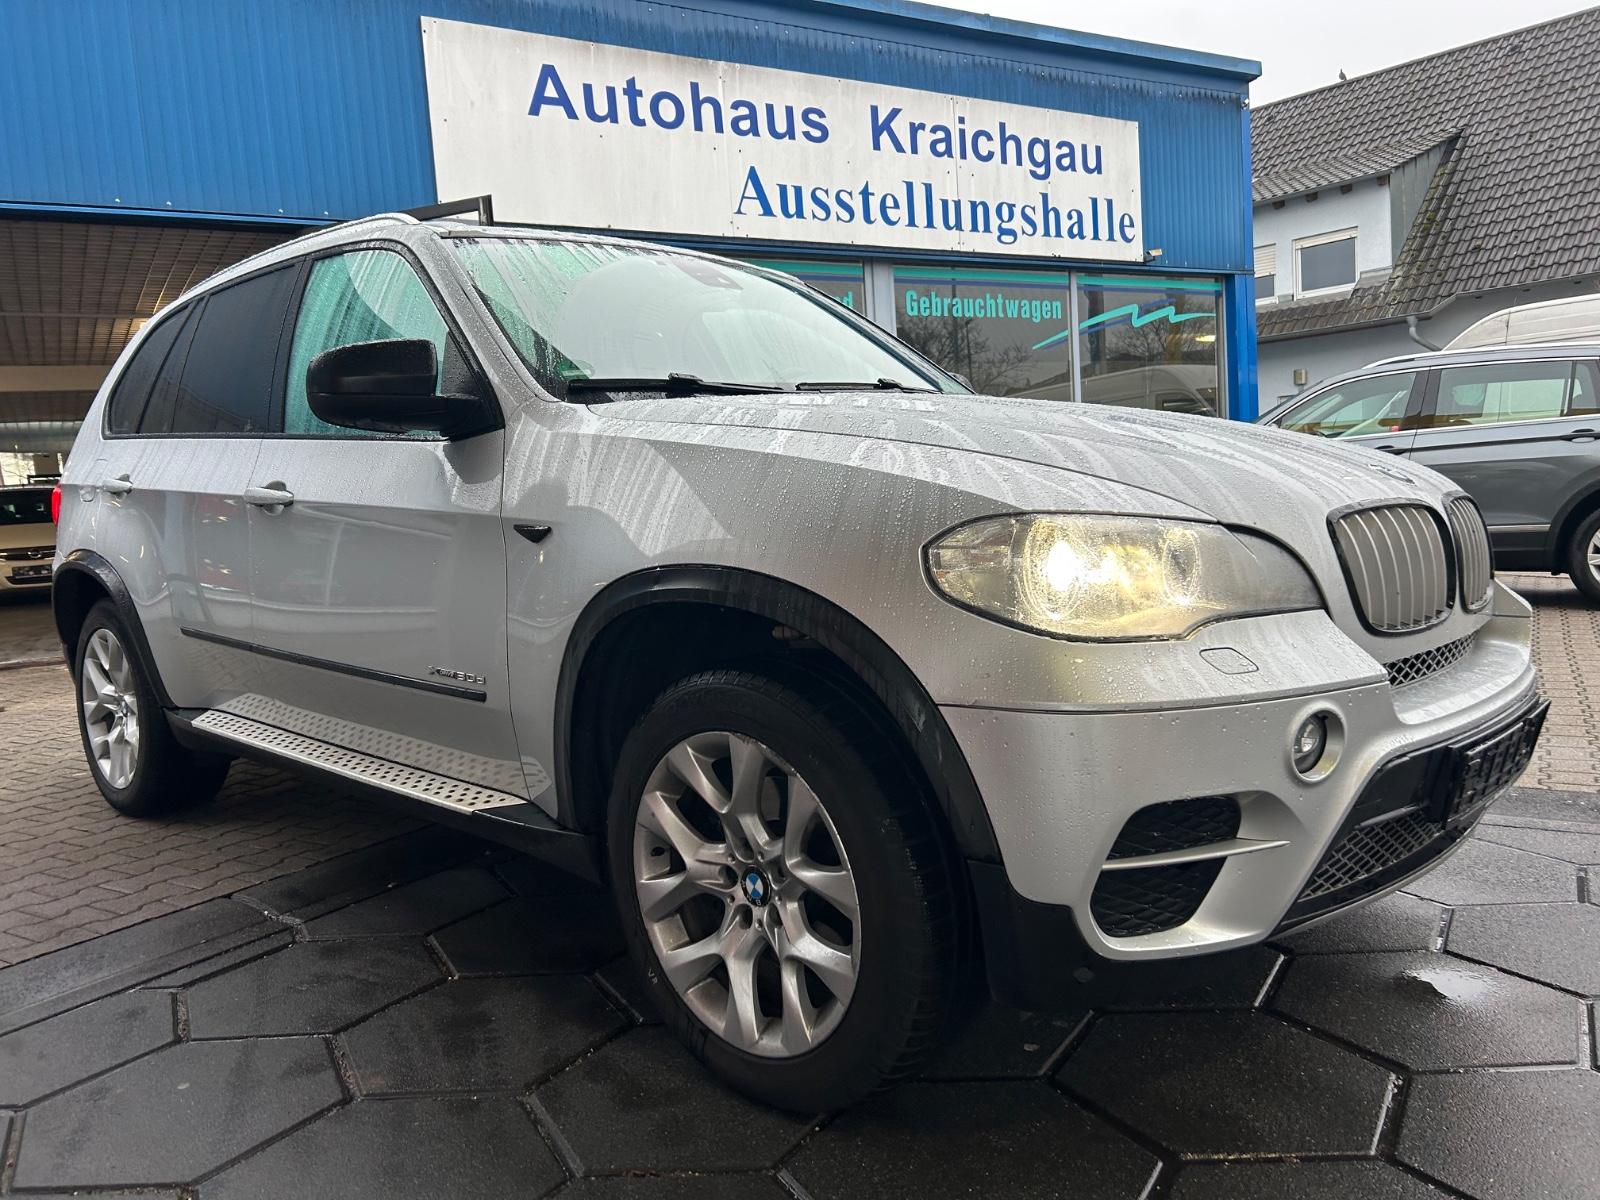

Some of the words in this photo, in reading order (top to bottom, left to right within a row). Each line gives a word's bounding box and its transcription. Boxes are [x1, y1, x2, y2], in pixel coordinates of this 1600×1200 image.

[528, 64, 829, 144] Autohaus
[870, 104, 1103, 181] Kraichgau
[736, 166, 1137, 245] Ausstellungshalle
[905, 289, 1063, 323] Gebrauchtwagen
